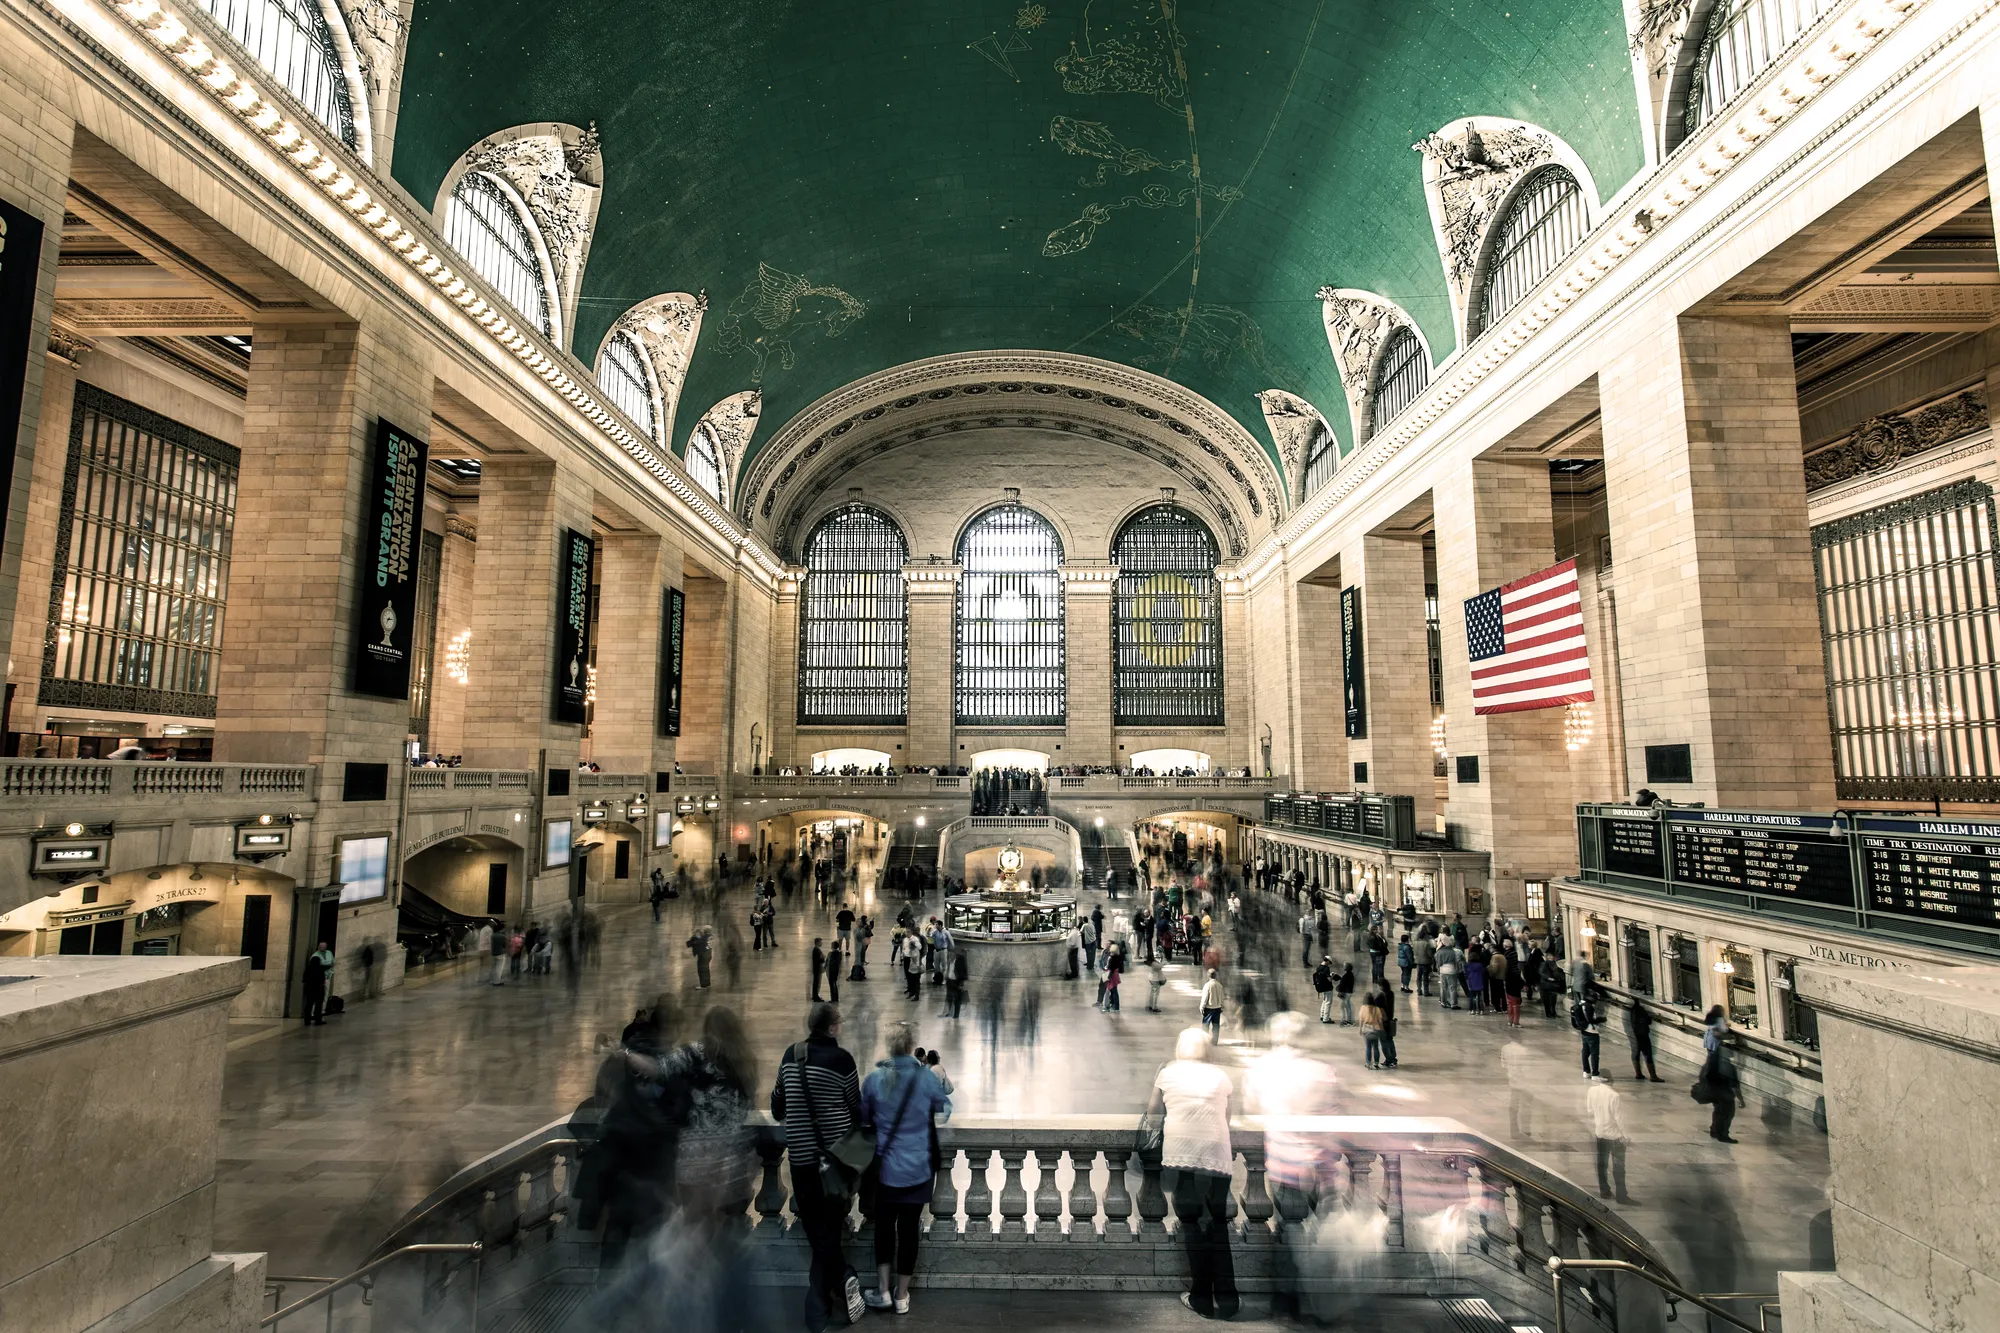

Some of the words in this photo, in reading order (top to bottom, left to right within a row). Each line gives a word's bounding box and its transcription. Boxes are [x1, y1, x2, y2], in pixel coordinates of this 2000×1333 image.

[408, 442, 418, 458] A
[386, 432, 400, 488] ISN'T
[384, 488, 394, 510] IT
[388, 440, 408, 575] CELEBRATION
[398, 463, 417, 583] CENTENNIAL
[376, 512, 392, 586] GRAND
[569, 566, 578, 624] MAKING
[574, 616, 580, 630] IN
[368, 644, 384, 652] GRAND
[384, 647, 403, 656] CENTRAL
[1150, 806, 1179, 815] LEXINGTON
[1613, 809, 1650, 817] INFORMATION
[1704, 813, 1733, 821] HARLEM
[1734, 814, 1751, 823] LINE
[1752, 815, 1801, 825] DEPARTURES
[493, 825, 510, 836] STREET
[1919, 823, 1969, 834] HARLEM
[1972, 825, 2000, 836] LINE
[413, 832, 438, 852] METLIFE
[439, 825, 464, 840] BUILDING
[1744, 840, 1768, 848] SCARSDALE
[1865, 838, 1885, 847] TIME
[1889, 840, 1908, 848] TRK
[1911, 841, 1972, 853] DESTINATION
[1872, 850, 1888, 859] 3:16
[1916, 854, 1952, 864] SOUTHEAST
[1761, 861, 1778, 869] PLAINS
[1874, 862, 1889, 870] 3:19
[1917, 866, 1925, 874] N.
[1928, 867, 1950, 876] WHITE
[1952, 869, 1979, 880] PLAINS
[1746, 869, 1770, 878] SCARSDALE
[1725, 875, 1741, 883] PLAINS
[1747, 879, 1766, 887] FORDHAM
[1875, 873, 1890, 882] 3:22
[1900, 876, 1912, 884] 104
[1930, 879, 1951, 889] WHITE
[1954, 881, 1980, 892] PLAINS
[156, 894, 164, 902] 28
[166, 888, 197, 899] TRACKS
[1876, 884, 1891, 893] 3:43
[1904, 888, 1913, 896] 24
[1920, 890, 1948, 900] WASSAIC
[1921, 902, 1957, 913] SOUTHEAST
[1809, 945, 1835, 960] MTA
[1839, 951, 1886, 967] METRO
